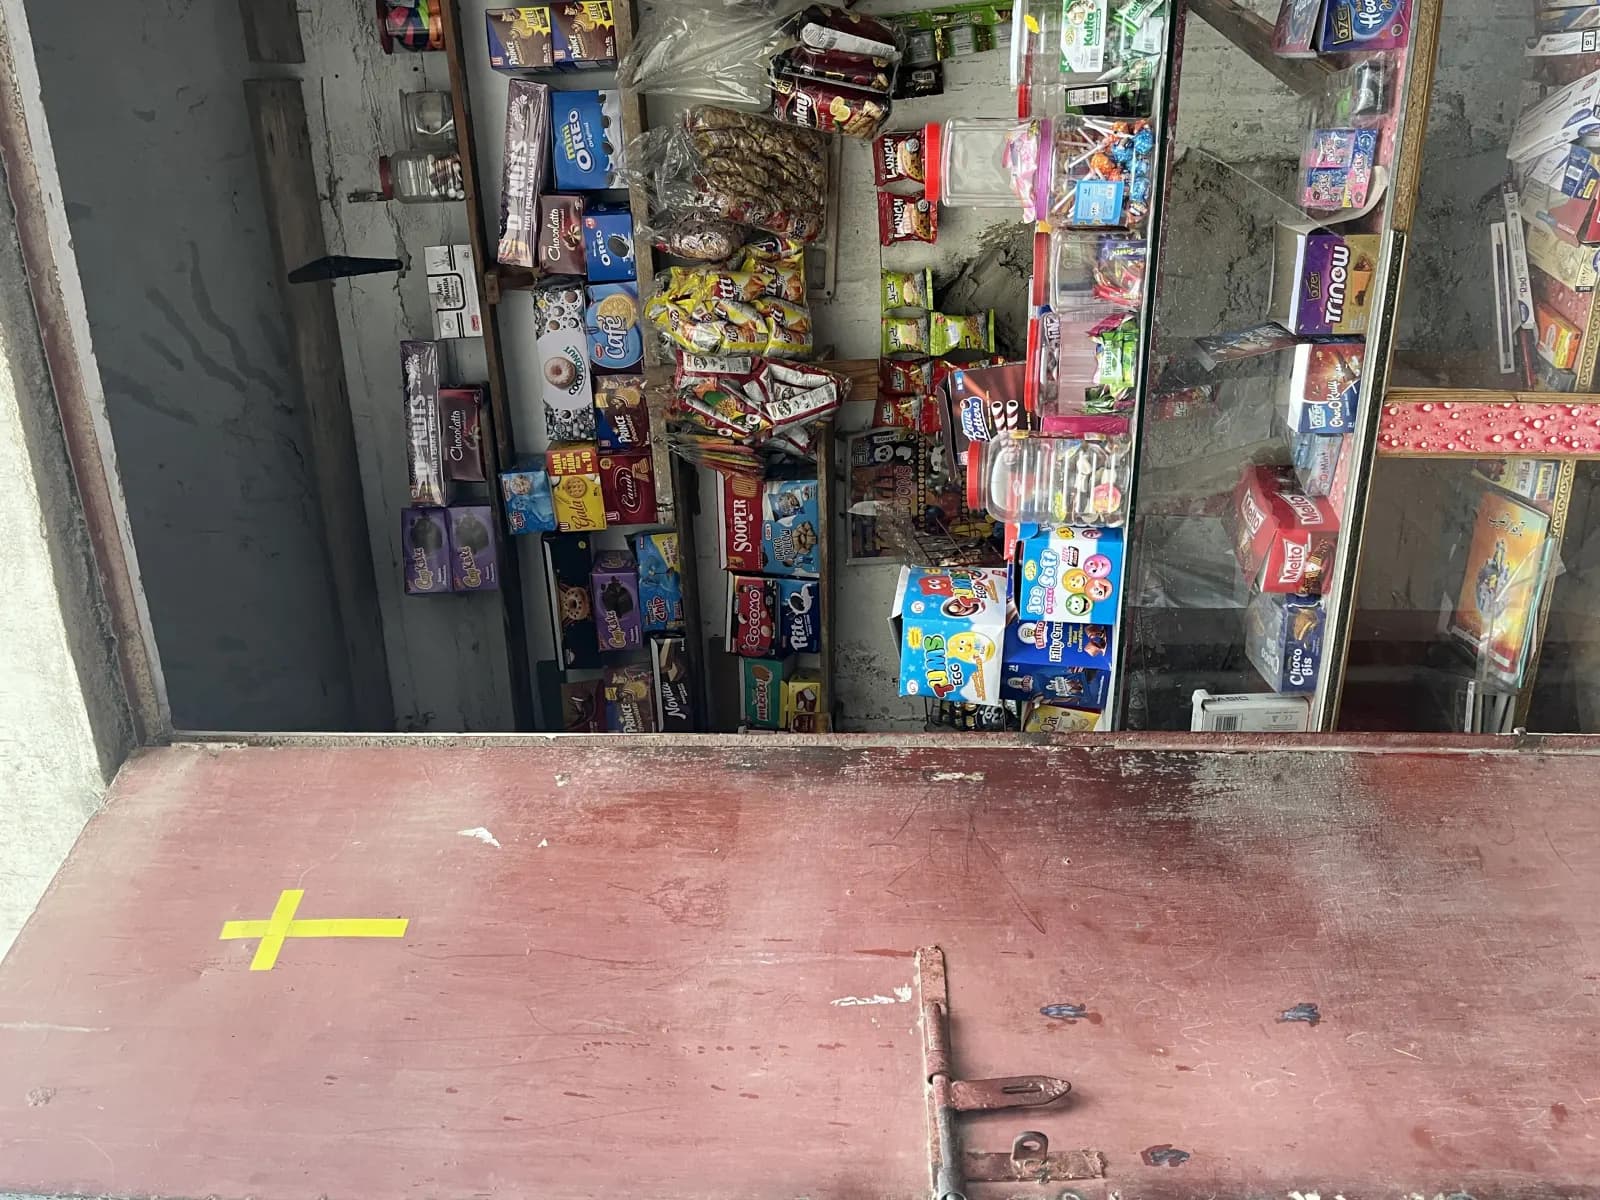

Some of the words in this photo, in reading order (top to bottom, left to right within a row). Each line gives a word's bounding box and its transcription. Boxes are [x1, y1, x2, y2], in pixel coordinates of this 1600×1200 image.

[1083, 12, 1094, 46] Kulfa
[505, 41, 520, 66] PRINCE
[569, 35, 582, 59] PRINCE
[561, 125, 575, 160] mini
[568, 110, 592, 170] OREO
[884, 138, 897, 179] LUNCH
[546, 208, 561, 262] Chocolatto
[893, 198, 907, 238] LUNCH
[595, 230, 610, 266] OREO
[597, 315, 627, 359] Café
[564, 345, 583, 373] DONUT
[568, 374, 584, 396] COCO
[448, 410, 463, 461] Chocolatto
[614, 415, 632, 443] PRINCE
[971, 402, 986, 440] Letters
[581, 452, 591, 464] 10
[619, 471, 636, 507] Candi
[568, 500, 596, 529] Gala
[733, 499, 752, 552] SOOPER
[1288, 496, 1321, 524] Melto
[1038, 549, 1059, 587] Soft
[1282, 546, 1303, 581] Melto
[973, 584, 987, 599] EGG
[1027, 586, 1045, 614] Joe
[745, 590, 761, 647] COCOMO
[791, 616, 809, 649] Rite
[923, 635, 955, 698] TUMS
[950, 664, 963, 686] EGG
[1289, 648, 1304, 686] Choco
[1302, 658, 1313, 676] Bis
[621, 703, 637, 732] PRINCE
[662, 682, 687, 720] Novita
